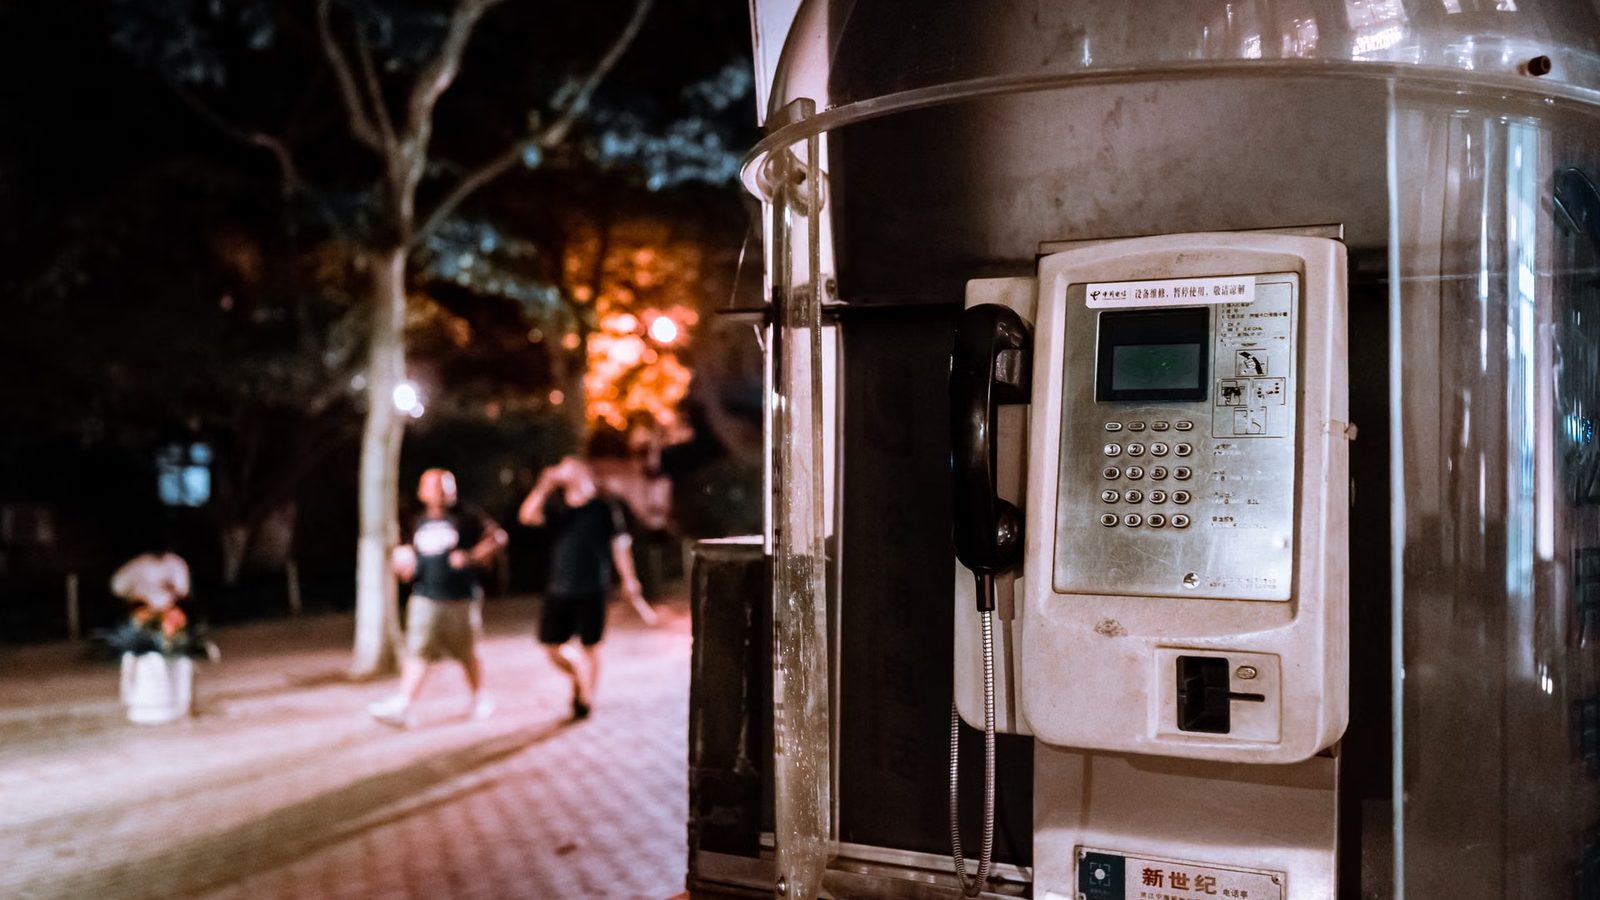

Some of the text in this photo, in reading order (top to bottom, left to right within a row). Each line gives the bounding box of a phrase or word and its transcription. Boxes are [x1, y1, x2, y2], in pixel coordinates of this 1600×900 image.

[1142, 867, 1217, 895] 新世纪
[1223, 889, 1248, 899] 电话亭
